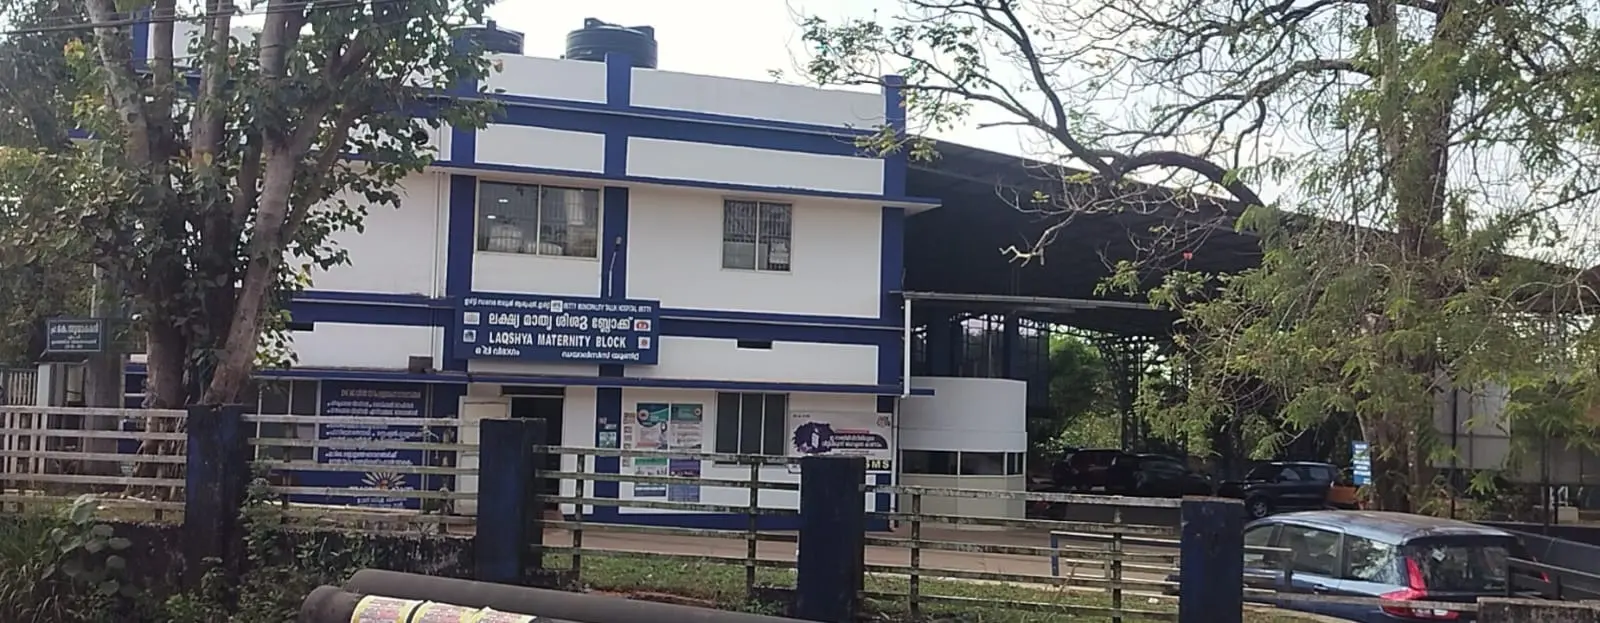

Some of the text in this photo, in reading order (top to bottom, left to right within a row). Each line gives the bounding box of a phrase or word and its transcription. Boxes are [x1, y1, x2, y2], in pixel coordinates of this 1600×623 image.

[488, 312, 520, 328] ലക്ഷ്യ
[555, 312, 588, 330] ശിശു
[489, 331, 626, 348] LAQSHYA MATERNITY BLOCK
